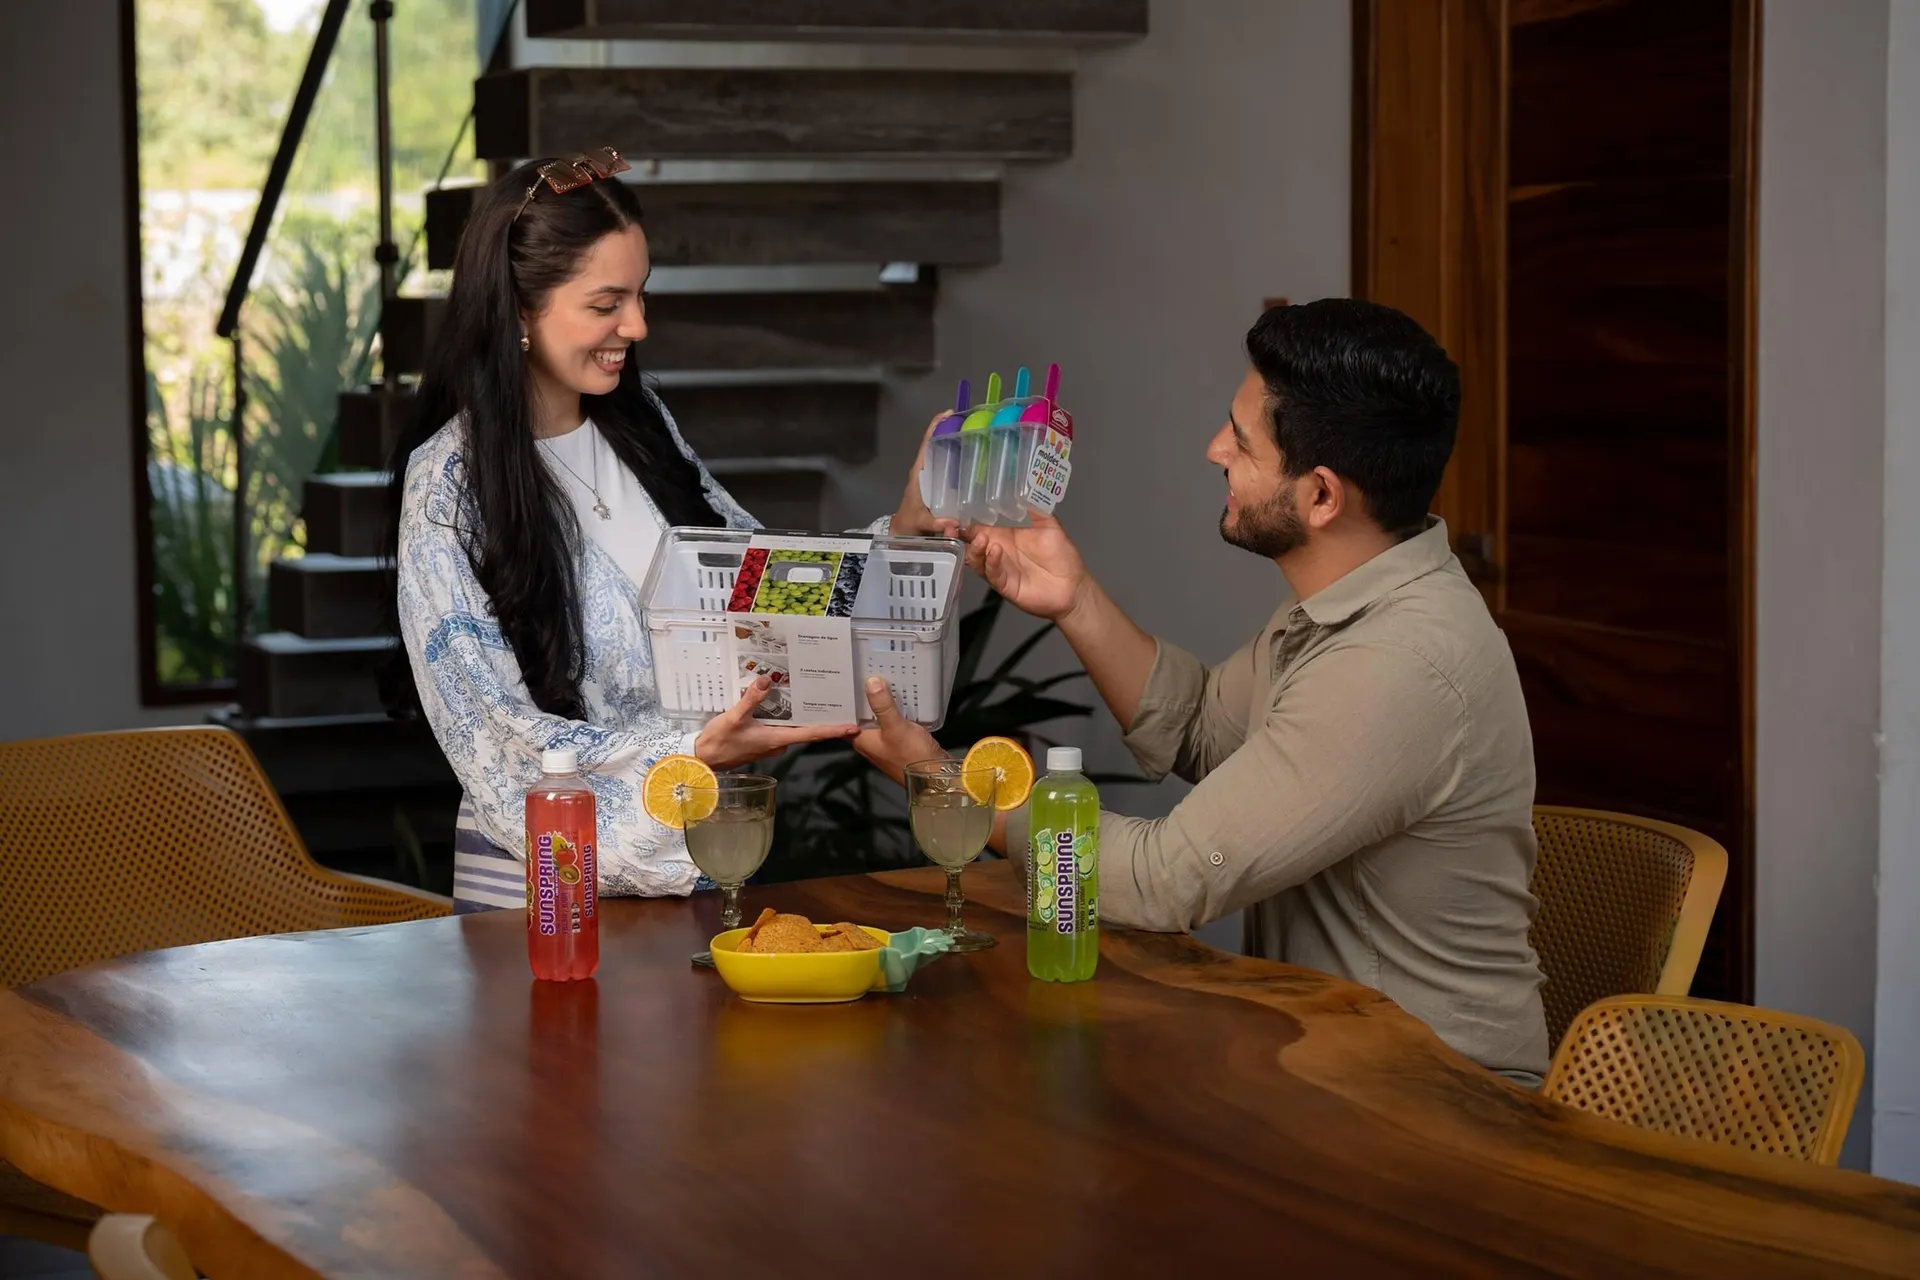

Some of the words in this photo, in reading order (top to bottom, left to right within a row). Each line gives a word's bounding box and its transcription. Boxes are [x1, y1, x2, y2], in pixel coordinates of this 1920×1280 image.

[1033, 458, 1066, 483] paletas
[1038, 450, 1059, 467] moldes
[1036, 472, 1062, 496] hielo
[538, 835, 555, 935] SUNSPRING
[583, 844, 593, 918] SUNSPRING
[1056, 833, 1074, 933] SUNSPRING
